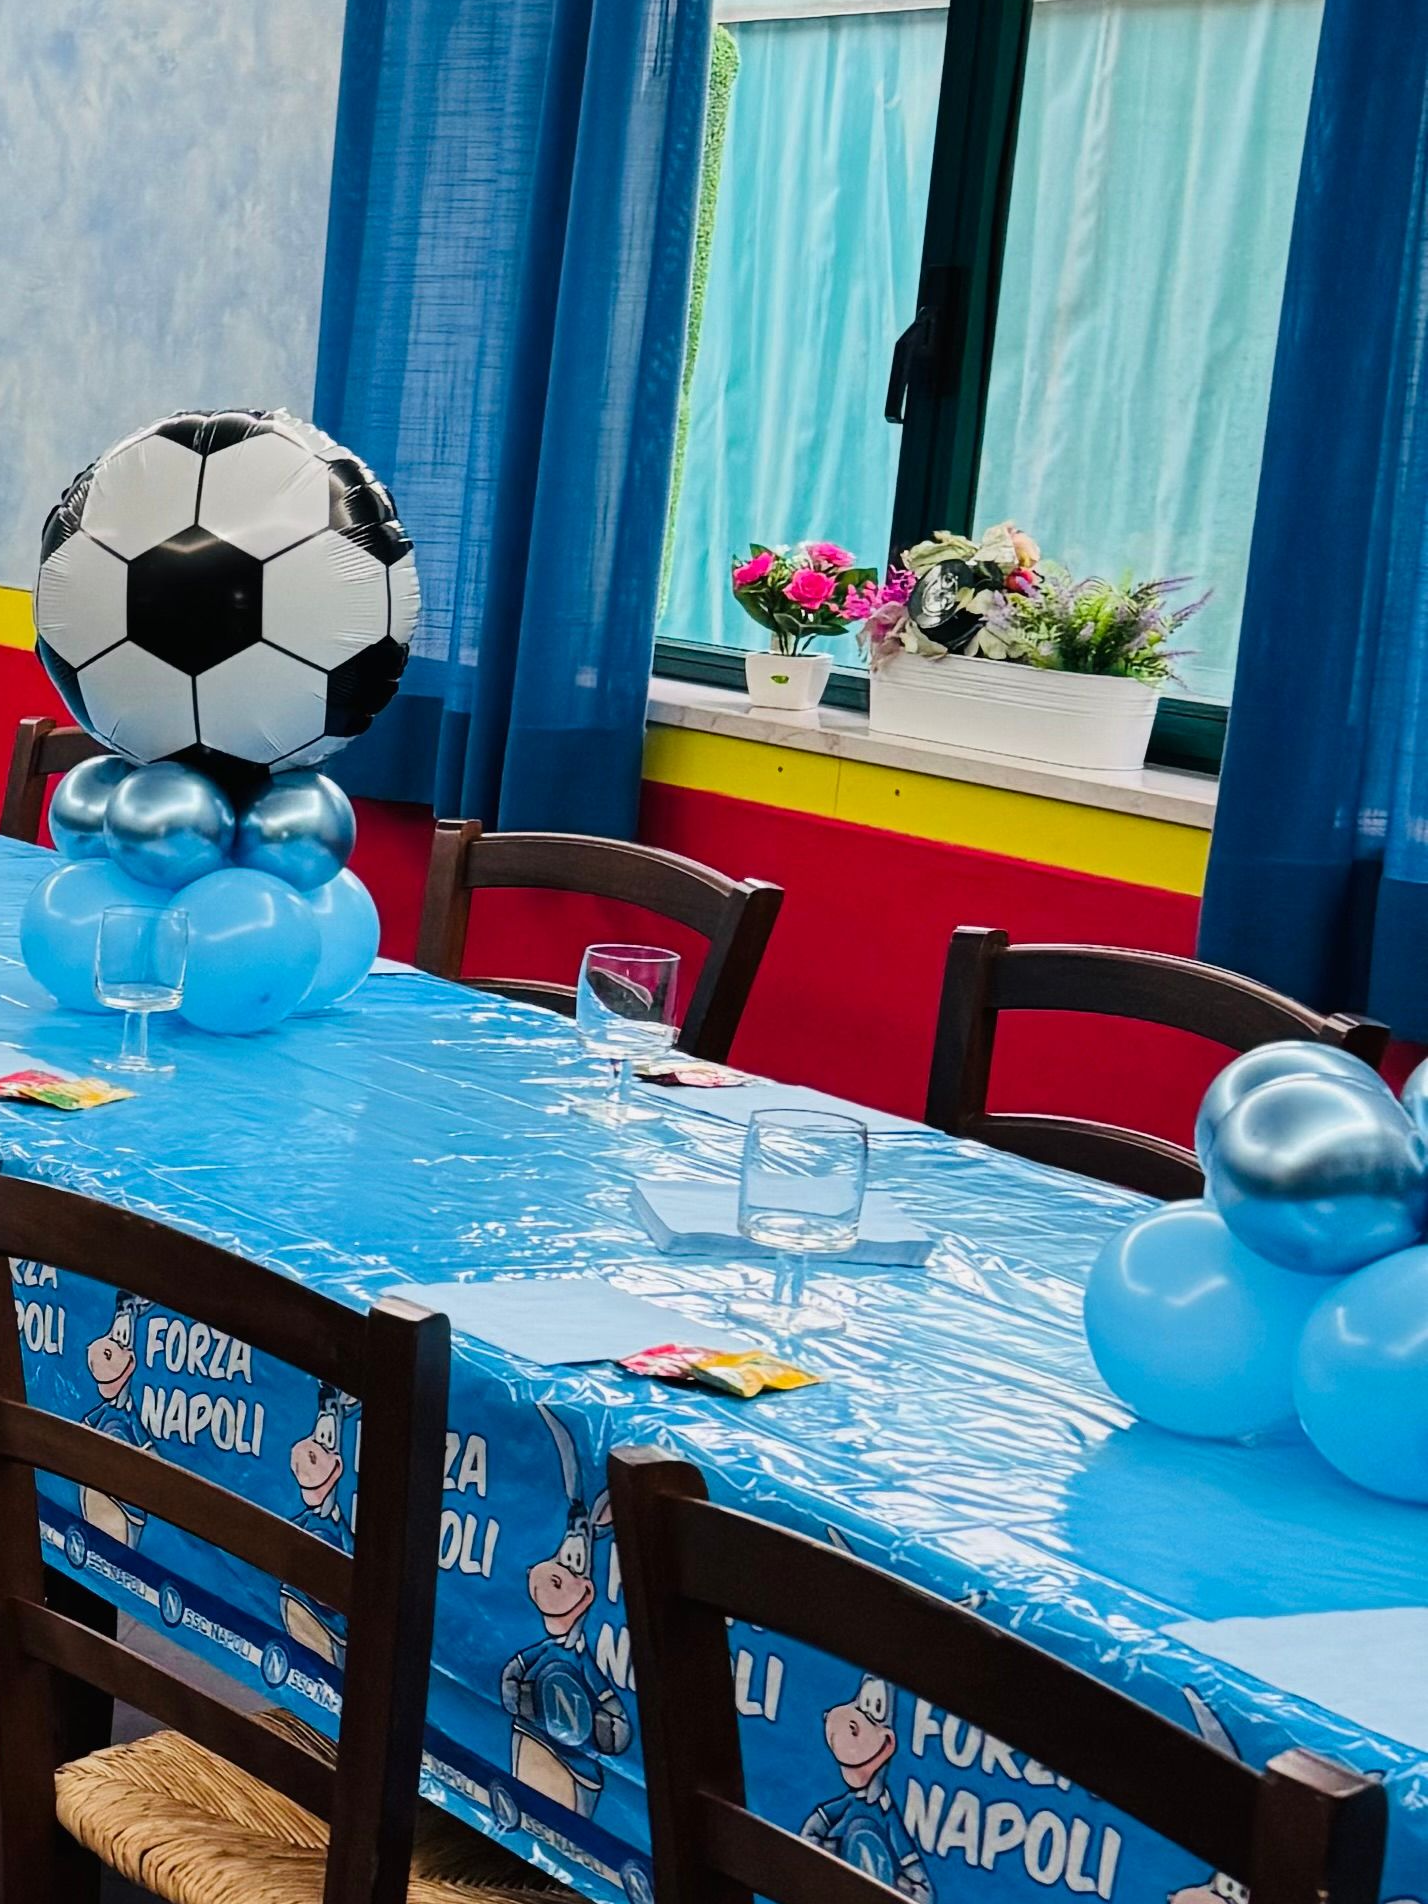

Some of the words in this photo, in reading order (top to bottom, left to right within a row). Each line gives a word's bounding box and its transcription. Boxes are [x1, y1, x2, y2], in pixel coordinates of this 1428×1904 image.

[146, 1317, 252, 1384] FORZA
[140, 1385, 265, 1457] NAPOLI
[185, 1609, 209, 1634] SSC
[211, 1623, 252, 1659] NAPOLI
[903, 1778, 1122, 1900] NAPOLI
